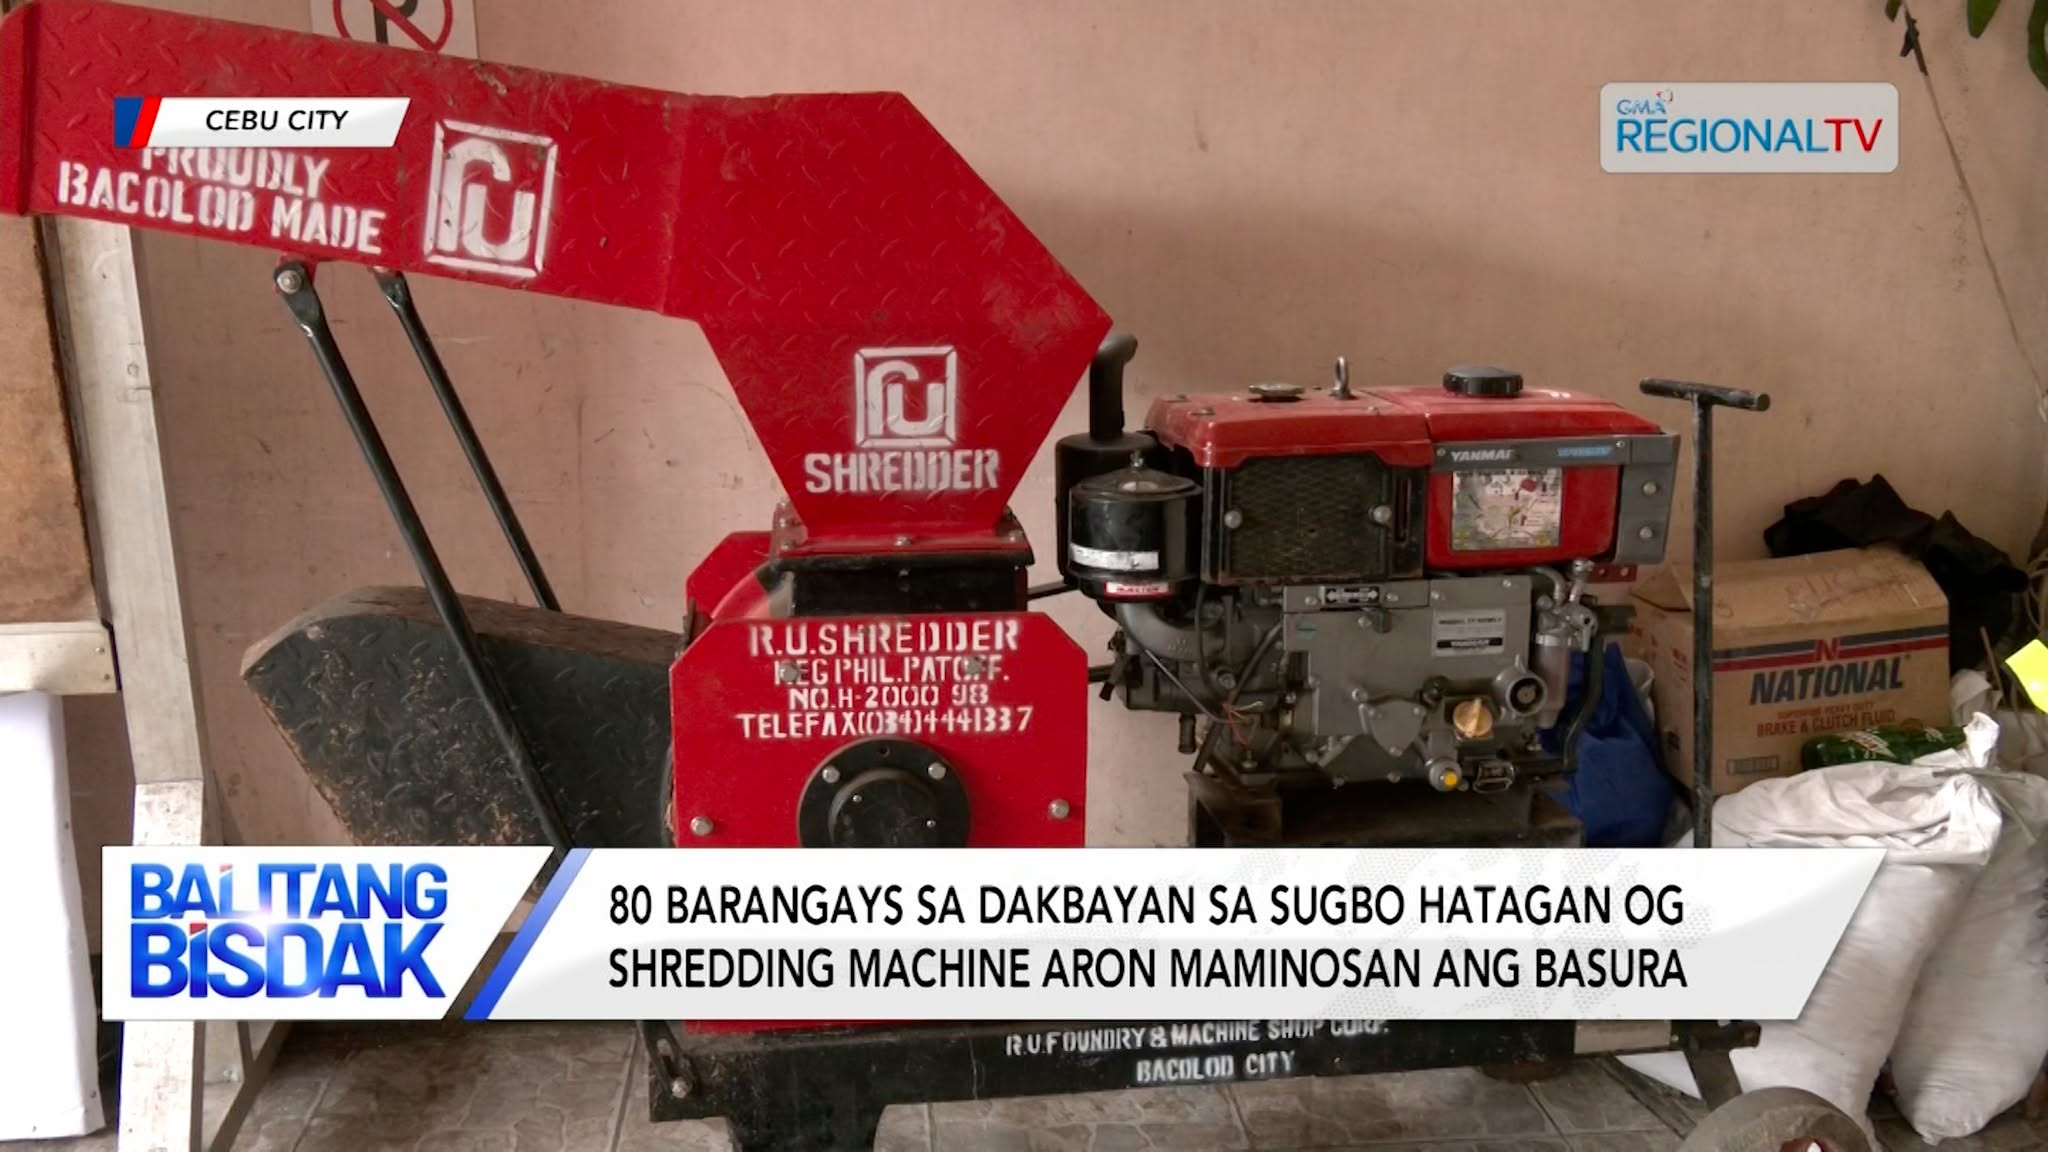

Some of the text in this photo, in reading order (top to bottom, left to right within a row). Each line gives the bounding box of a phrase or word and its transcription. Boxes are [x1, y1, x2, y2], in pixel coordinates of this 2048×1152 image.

[141, 147, 330, 199] PROUDLY
[57, 160, 386, 255] BACOLOD MADE
[804, 449, 999, 493] SHREDDER
[1750, 656, 1904, 706] NATIONAL
[1757, 719, 1796, 738] BRAKE
[1813, 714, 1858, 732] CLUTCH
[1861, 709, 1895, 728] FLUID
[1171, 1020, 1260, 1046] MACHINE
[1268, 1020, 1323, 1039] SHOP
[1136, 1050, 1296, 1083] BACOLOD CITY
